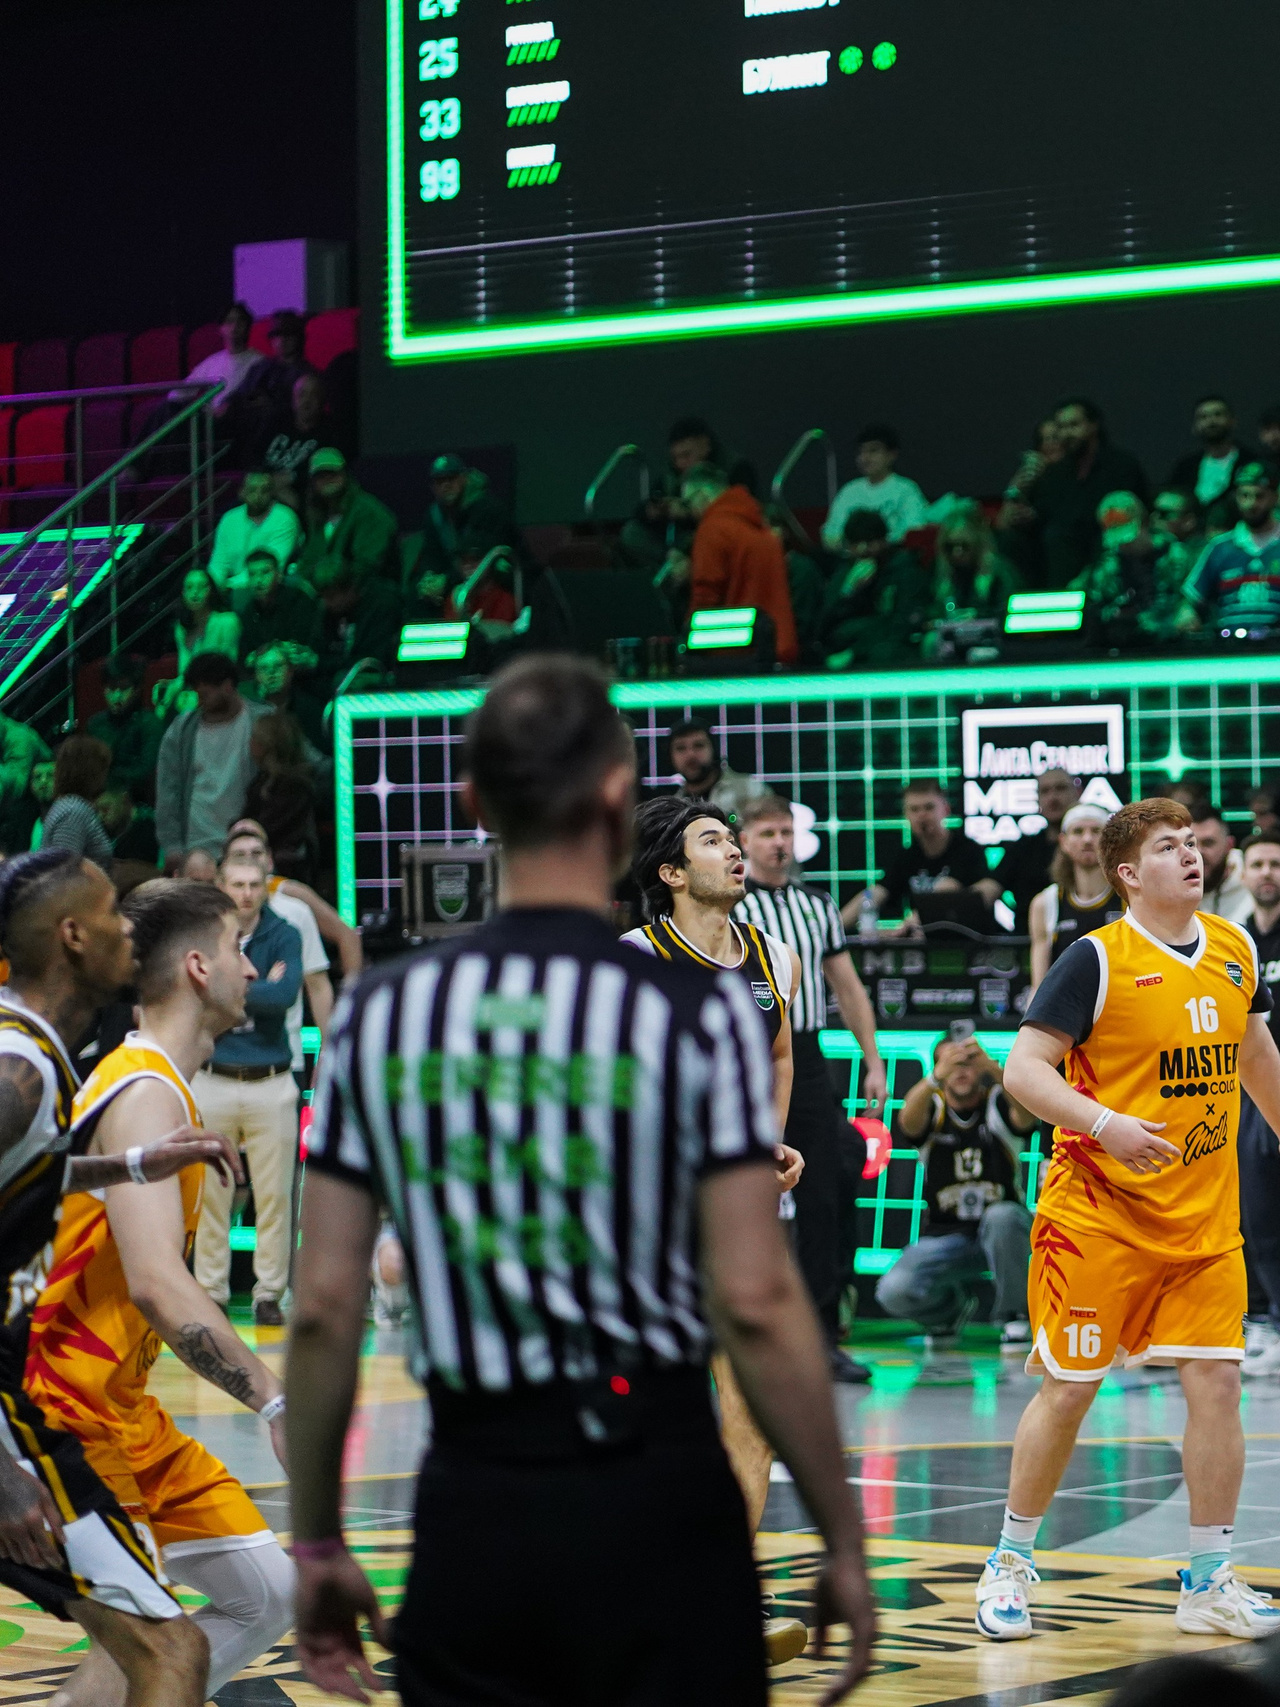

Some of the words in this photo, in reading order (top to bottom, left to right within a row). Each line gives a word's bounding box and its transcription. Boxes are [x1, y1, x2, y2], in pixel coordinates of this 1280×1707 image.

[419, 37, 459, 82] 25
[419, 97, 461, 142] 33
[419, 158, 461, 203] 99
[1135, 976, 1163, 988] RED
[1184, 995, 1220, 1034] 16
[1159, 1042, 1239, 1081] MASTER
[1069, 1310, 1097, 1318] RED
[1063, 1322, 1102, 1359] 16
